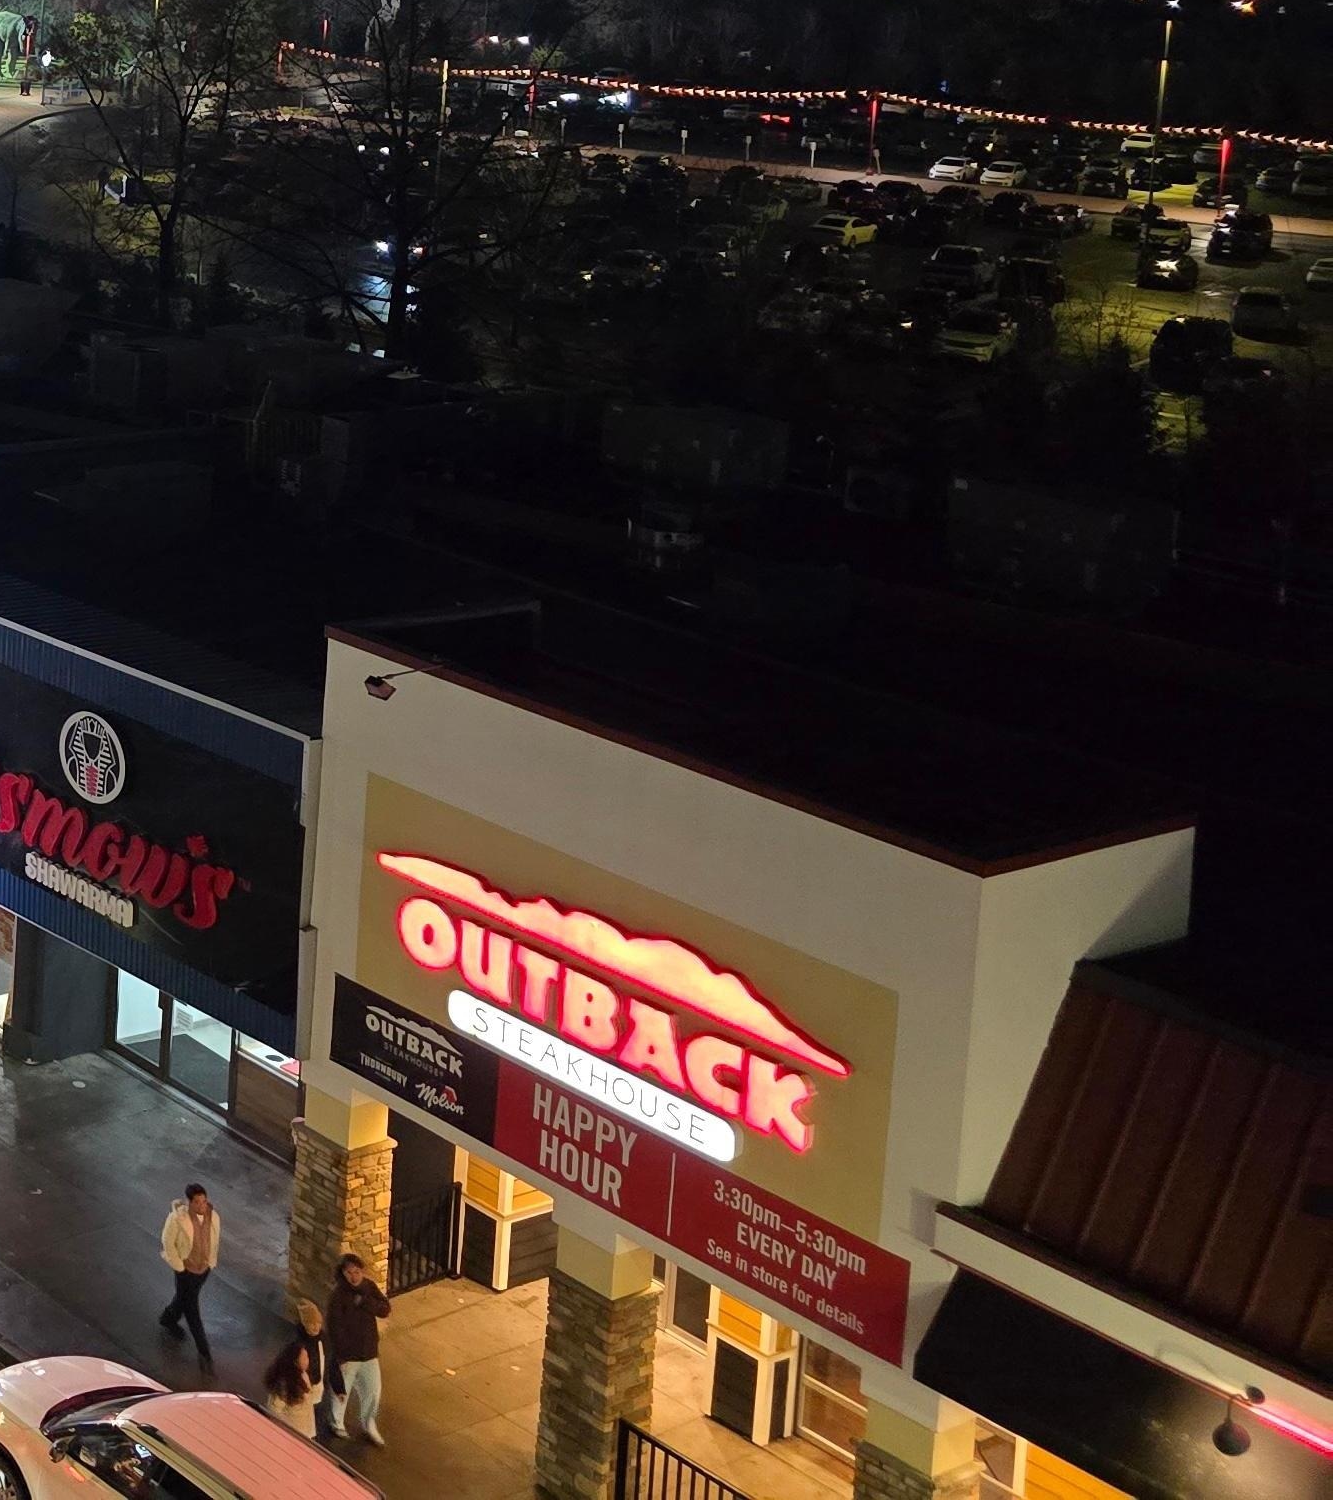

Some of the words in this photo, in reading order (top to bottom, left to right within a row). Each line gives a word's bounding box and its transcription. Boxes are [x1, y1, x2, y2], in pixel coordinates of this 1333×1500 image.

[25, 851, 134, 928] SHAWARMA
[365, 1013, 464, 1079] OUTBACK
[398, 897, 815, 1154] OUTBACK
[359, 1052, 408, 1087] THORNBURY
[415, 1083, 464, 1116] Molson
[472, 1006, 707, 1145] STEAKHOUSE
[533, 1082, 638, 1168] HAPPY
[539, 1136, 622, 1208] HOUR
[706, 1238, 731, 1264] See
[735, 1253, 748, 1273] in
[751, 1265, 788, 1294] store
[792, 1283, 813, 1308] for
[816, 1297, 864, 1336] details
[737, 1221, 796, 1269] EVERY
[801, 1256, 837, 1291] DAY
